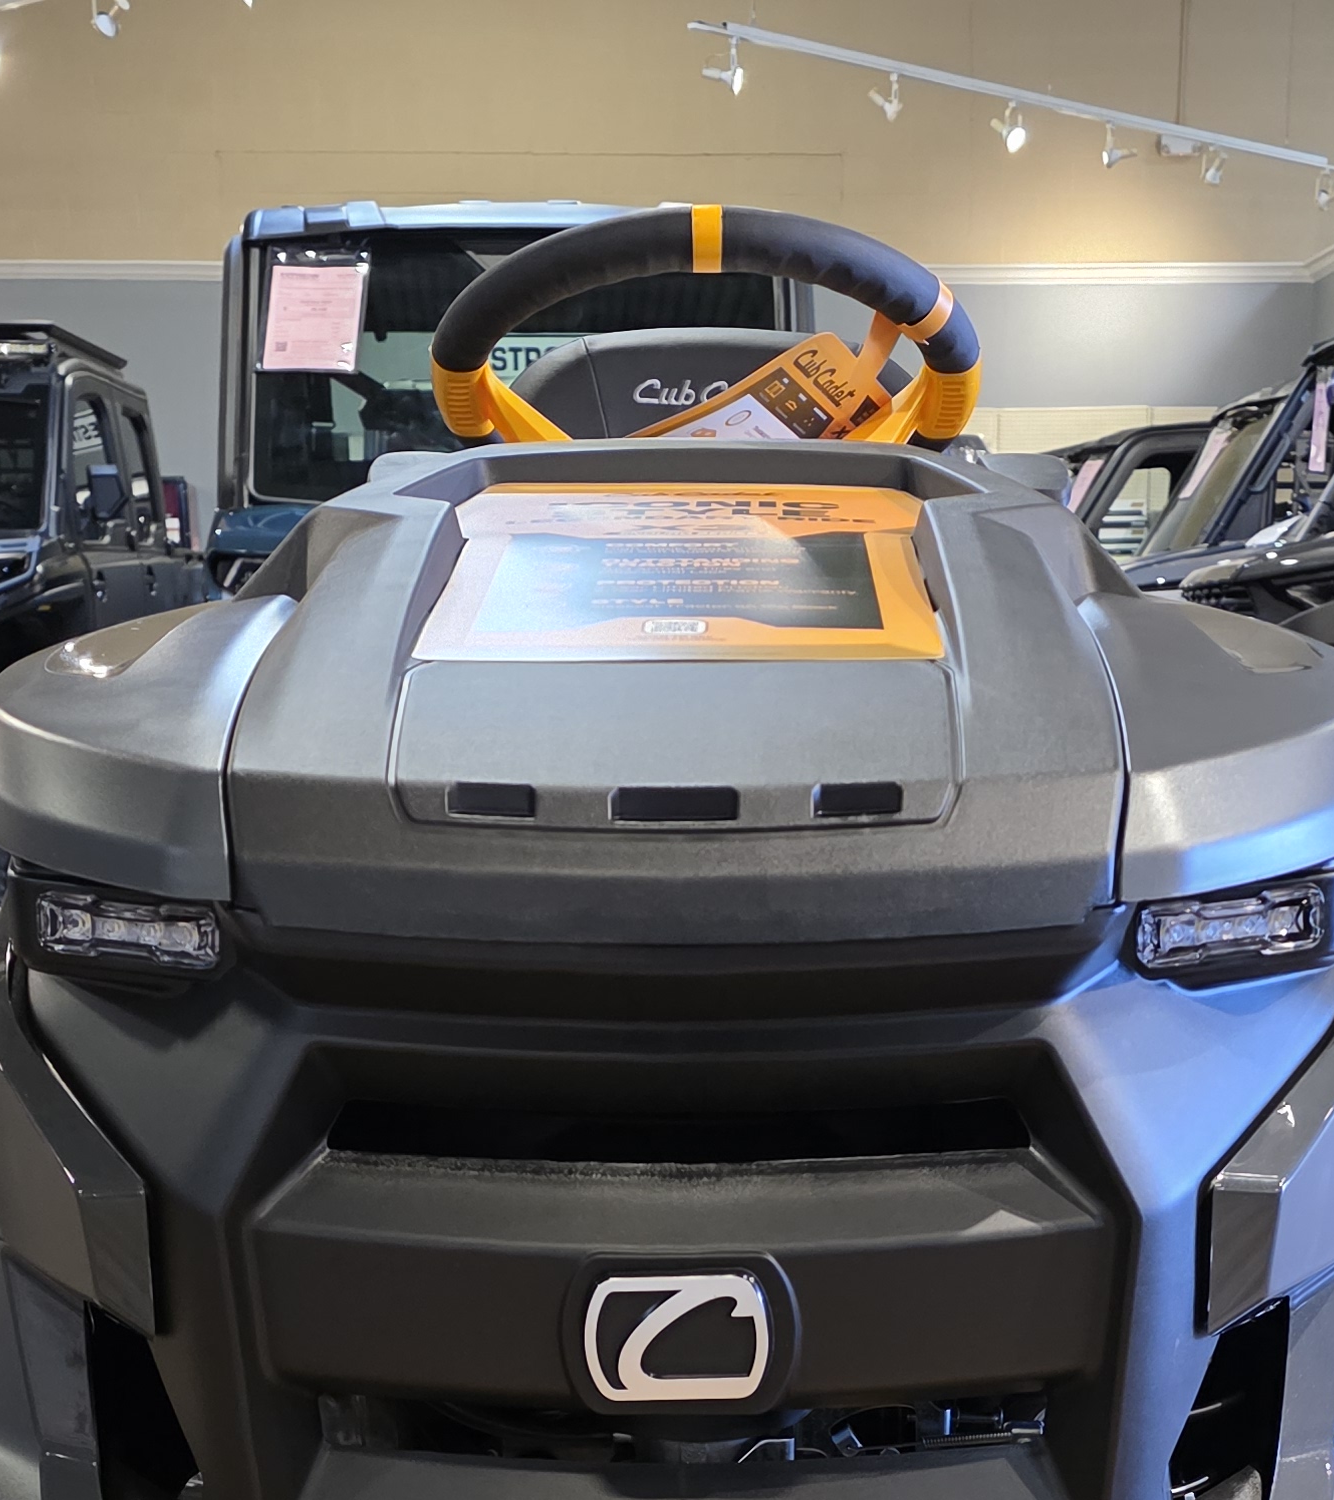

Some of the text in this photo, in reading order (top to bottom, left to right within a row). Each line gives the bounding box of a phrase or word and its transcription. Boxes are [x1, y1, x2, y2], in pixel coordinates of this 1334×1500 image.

[491, 346, 558, 371] STR
[792, 349, 856, 408] Cub Cadet
[633, 379, 696, 405] Cub
